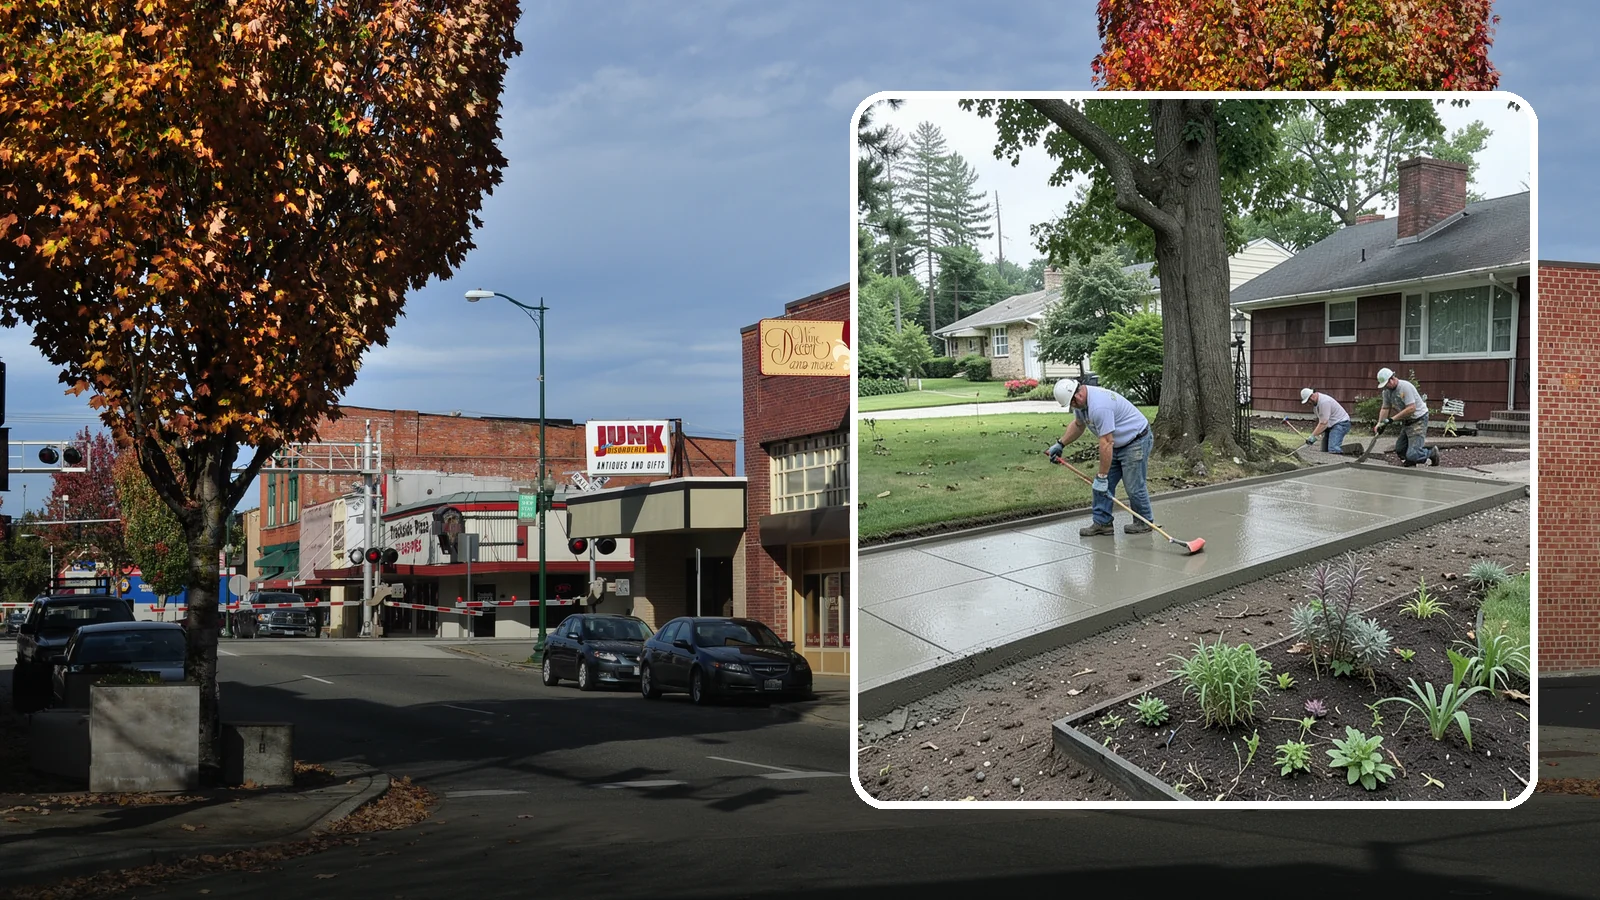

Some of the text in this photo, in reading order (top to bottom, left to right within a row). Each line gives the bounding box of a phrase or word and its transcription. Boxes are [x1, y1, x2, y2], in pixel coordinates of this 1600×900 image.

[596, 425, 664, 457] JUNK
[607, 446, 646, 454] DISORDERLY
[596, 460, 665, 470] ANTIQUES AND GIFTS
[390, 519, 429, 540] Trackside Pizza
